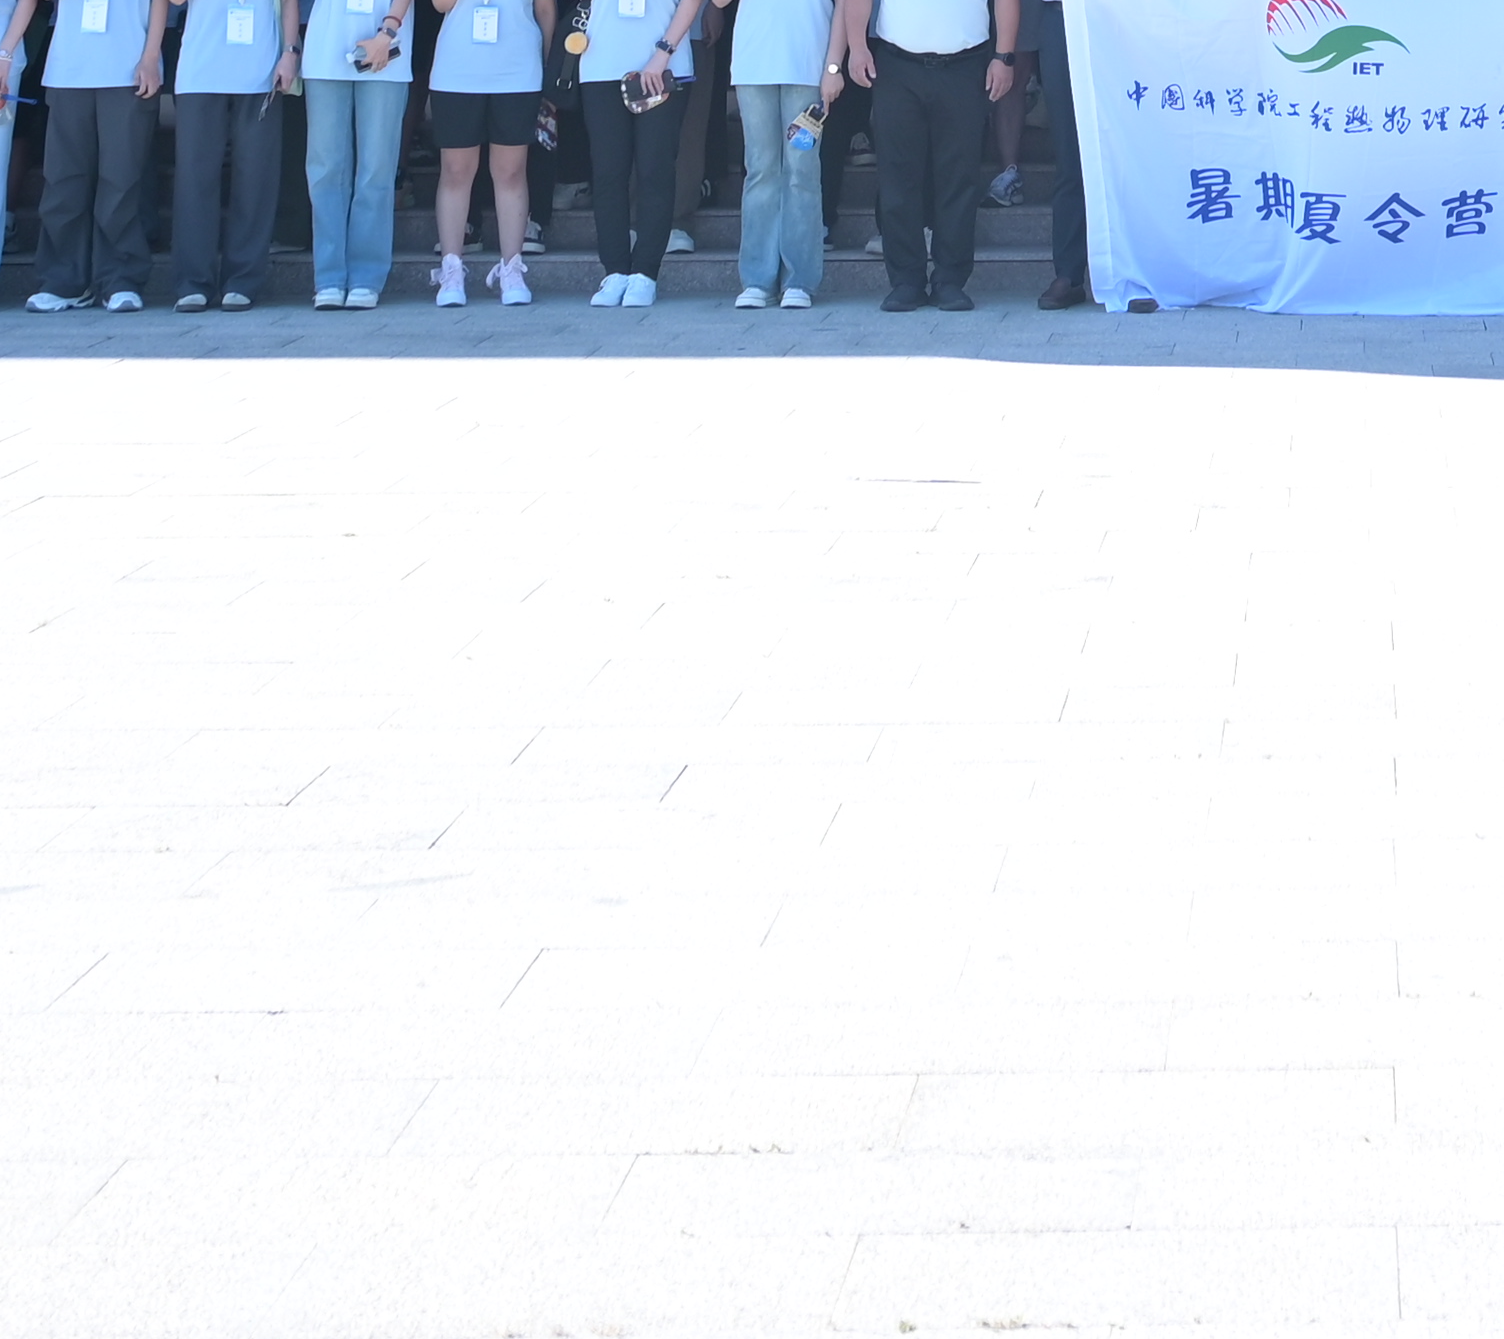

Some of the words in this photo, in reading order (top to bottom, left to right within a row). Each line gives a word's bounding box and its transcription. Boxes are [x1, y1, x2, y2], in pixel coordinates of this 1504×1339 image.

[1352, 61, 1385, 76] IET
[1186, 168, 1498, 244] 暑期夏令营
